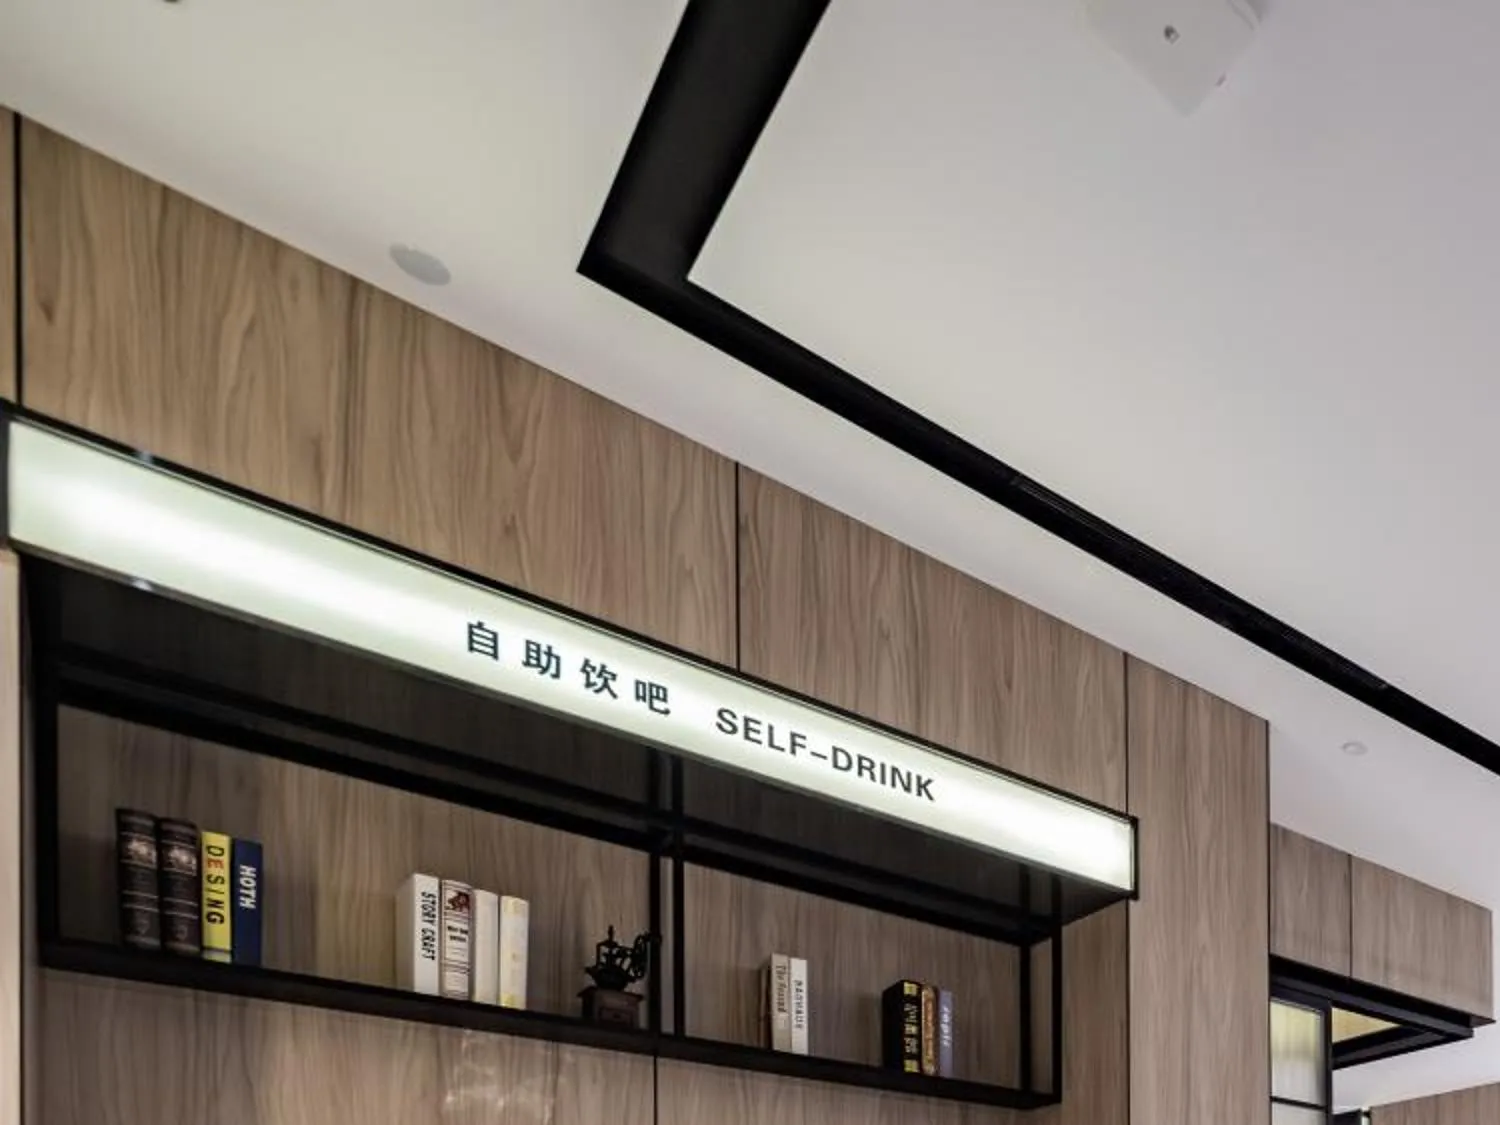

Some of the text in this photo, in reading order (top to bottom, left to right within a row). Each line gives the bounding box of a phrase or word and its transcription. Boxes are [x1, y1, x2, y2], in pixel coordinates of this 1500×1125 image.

[466, 621, 936, 801] 自助饮吧 SELF-DRINK
[206, 845, 225, 925] DESING
[420, 891, 437, 926] STORY
